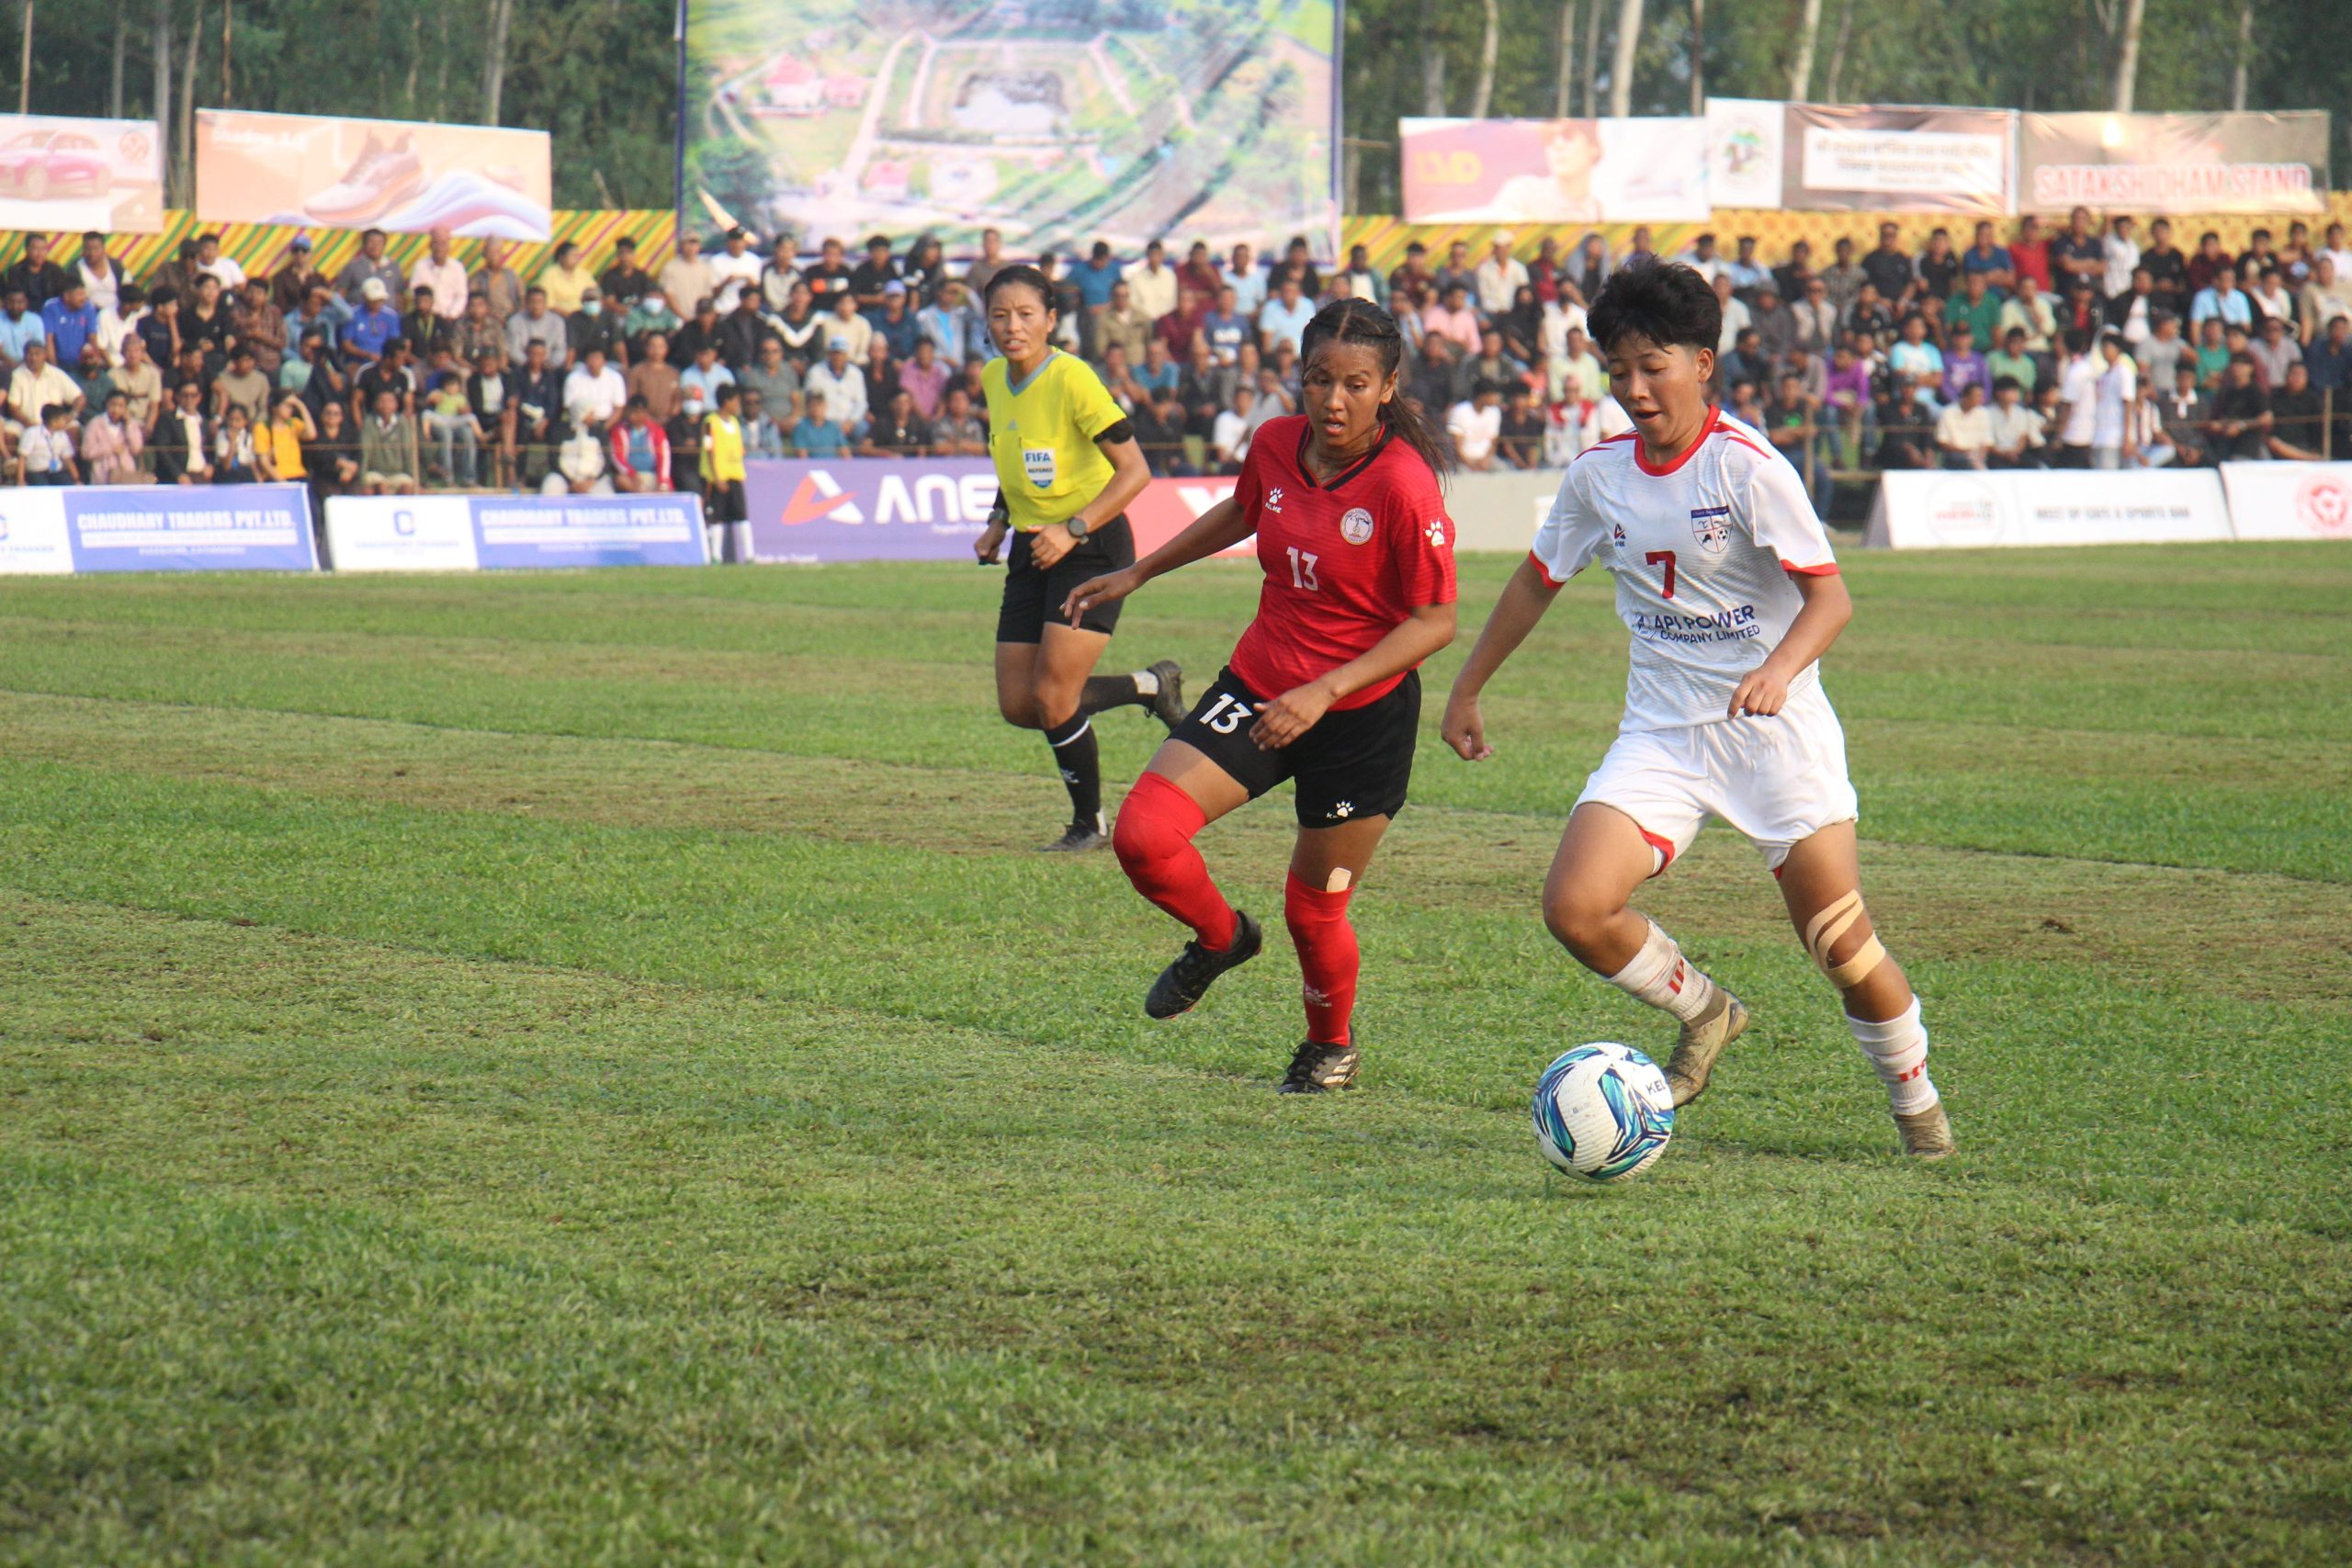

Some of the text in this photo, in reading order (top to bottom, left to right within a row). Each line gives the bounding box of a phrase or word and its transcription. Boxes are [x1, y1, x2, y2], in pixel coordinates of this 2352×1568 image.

[2230, 164, 2311, 198] STAND
[1025, 452, 1051, 462] FIFA
[77, 512, 164, 530] CHAUDHARY
[168, 511, 233, 529] TRADERS
[566, 509, 628, 525] TRADERS
[1286, 546, 1318, 591] 13
[1645, 550, 1676, 599] 7
[1655, 604, 1756, 630] API POWER
[1660, 624, 1760, 644] COMPANY LIMITED
[1199, 693, 1253, 734] 13
